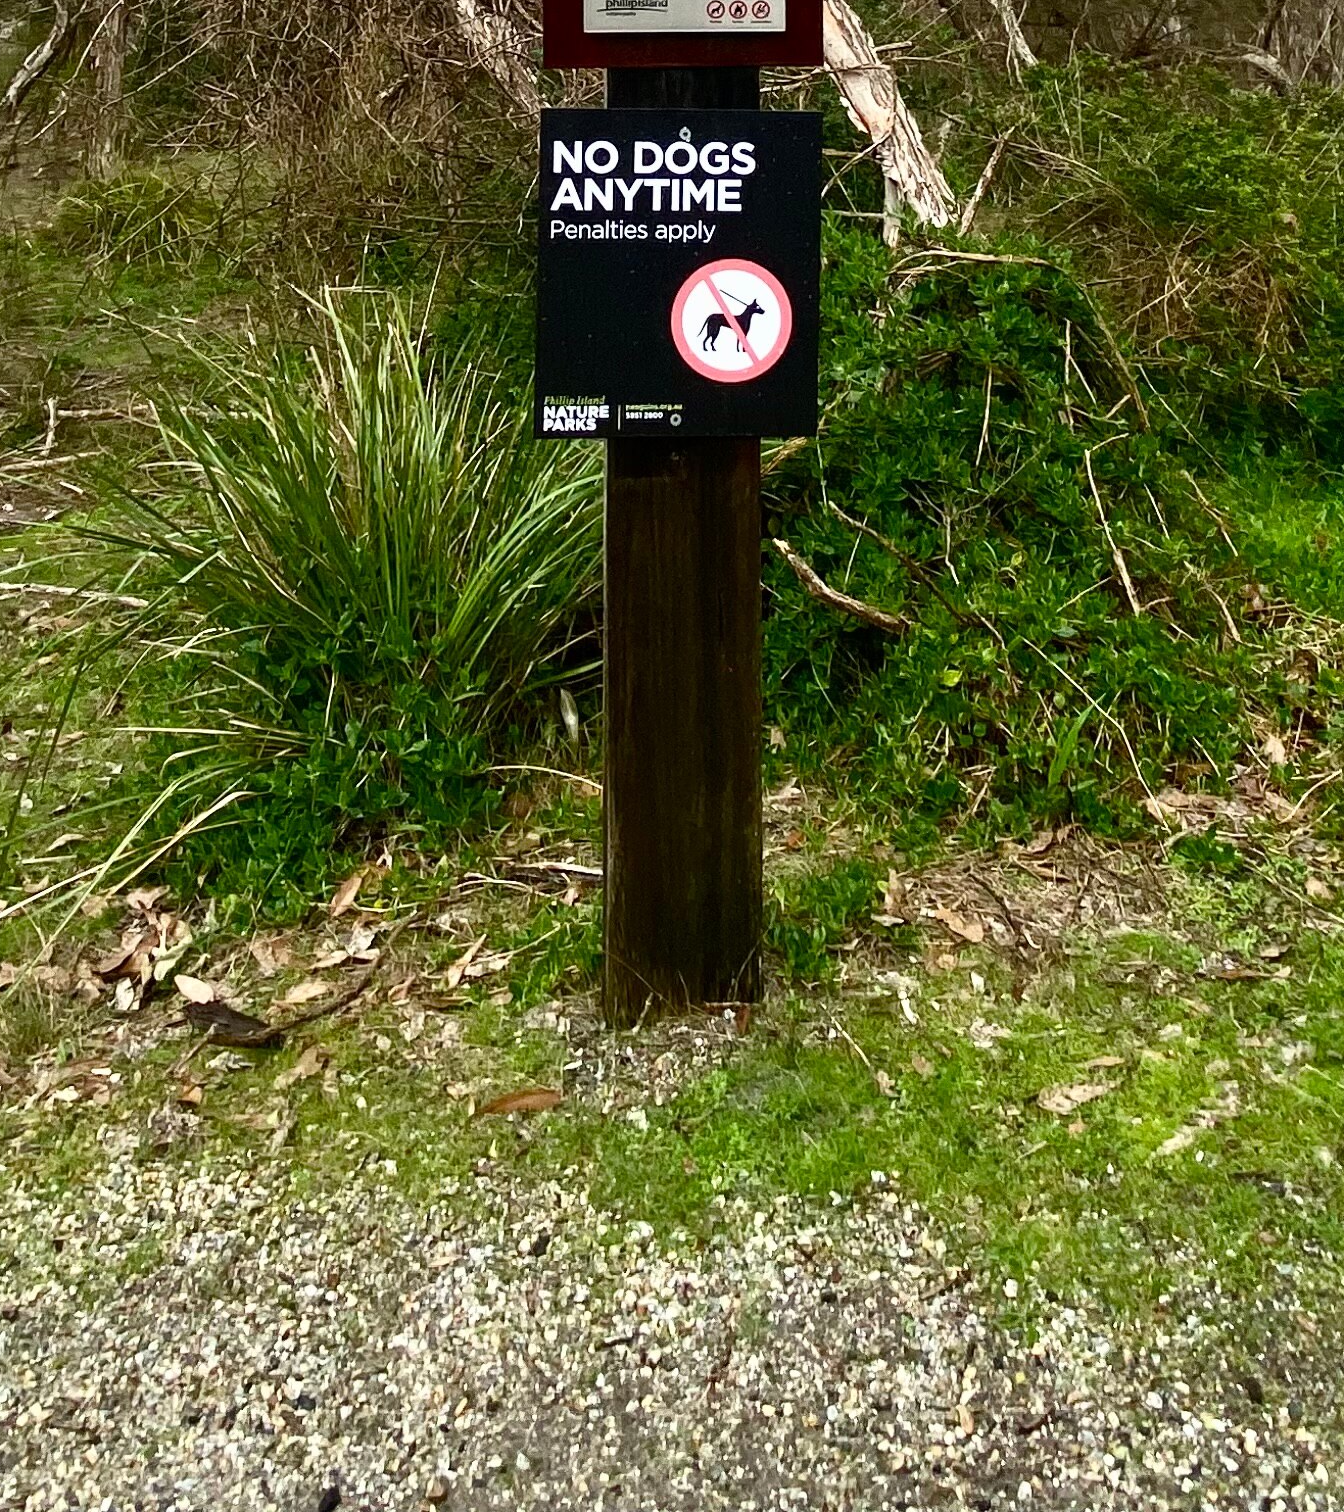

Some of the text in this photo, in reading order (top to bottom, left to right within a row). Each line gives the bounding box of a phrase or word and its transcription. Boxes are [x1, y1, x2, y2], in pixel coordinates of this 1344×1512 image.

[552, 140, 756, 176] NO DOGS
[550, 178, 743, 212] ANYTIME
[550, 220, 716, 243] Penalties apply
[544, 395, 606, 406] Phillip Island
[543, 405, 610, 419] NATURE
[543, 418, 597, 431] PARKS
